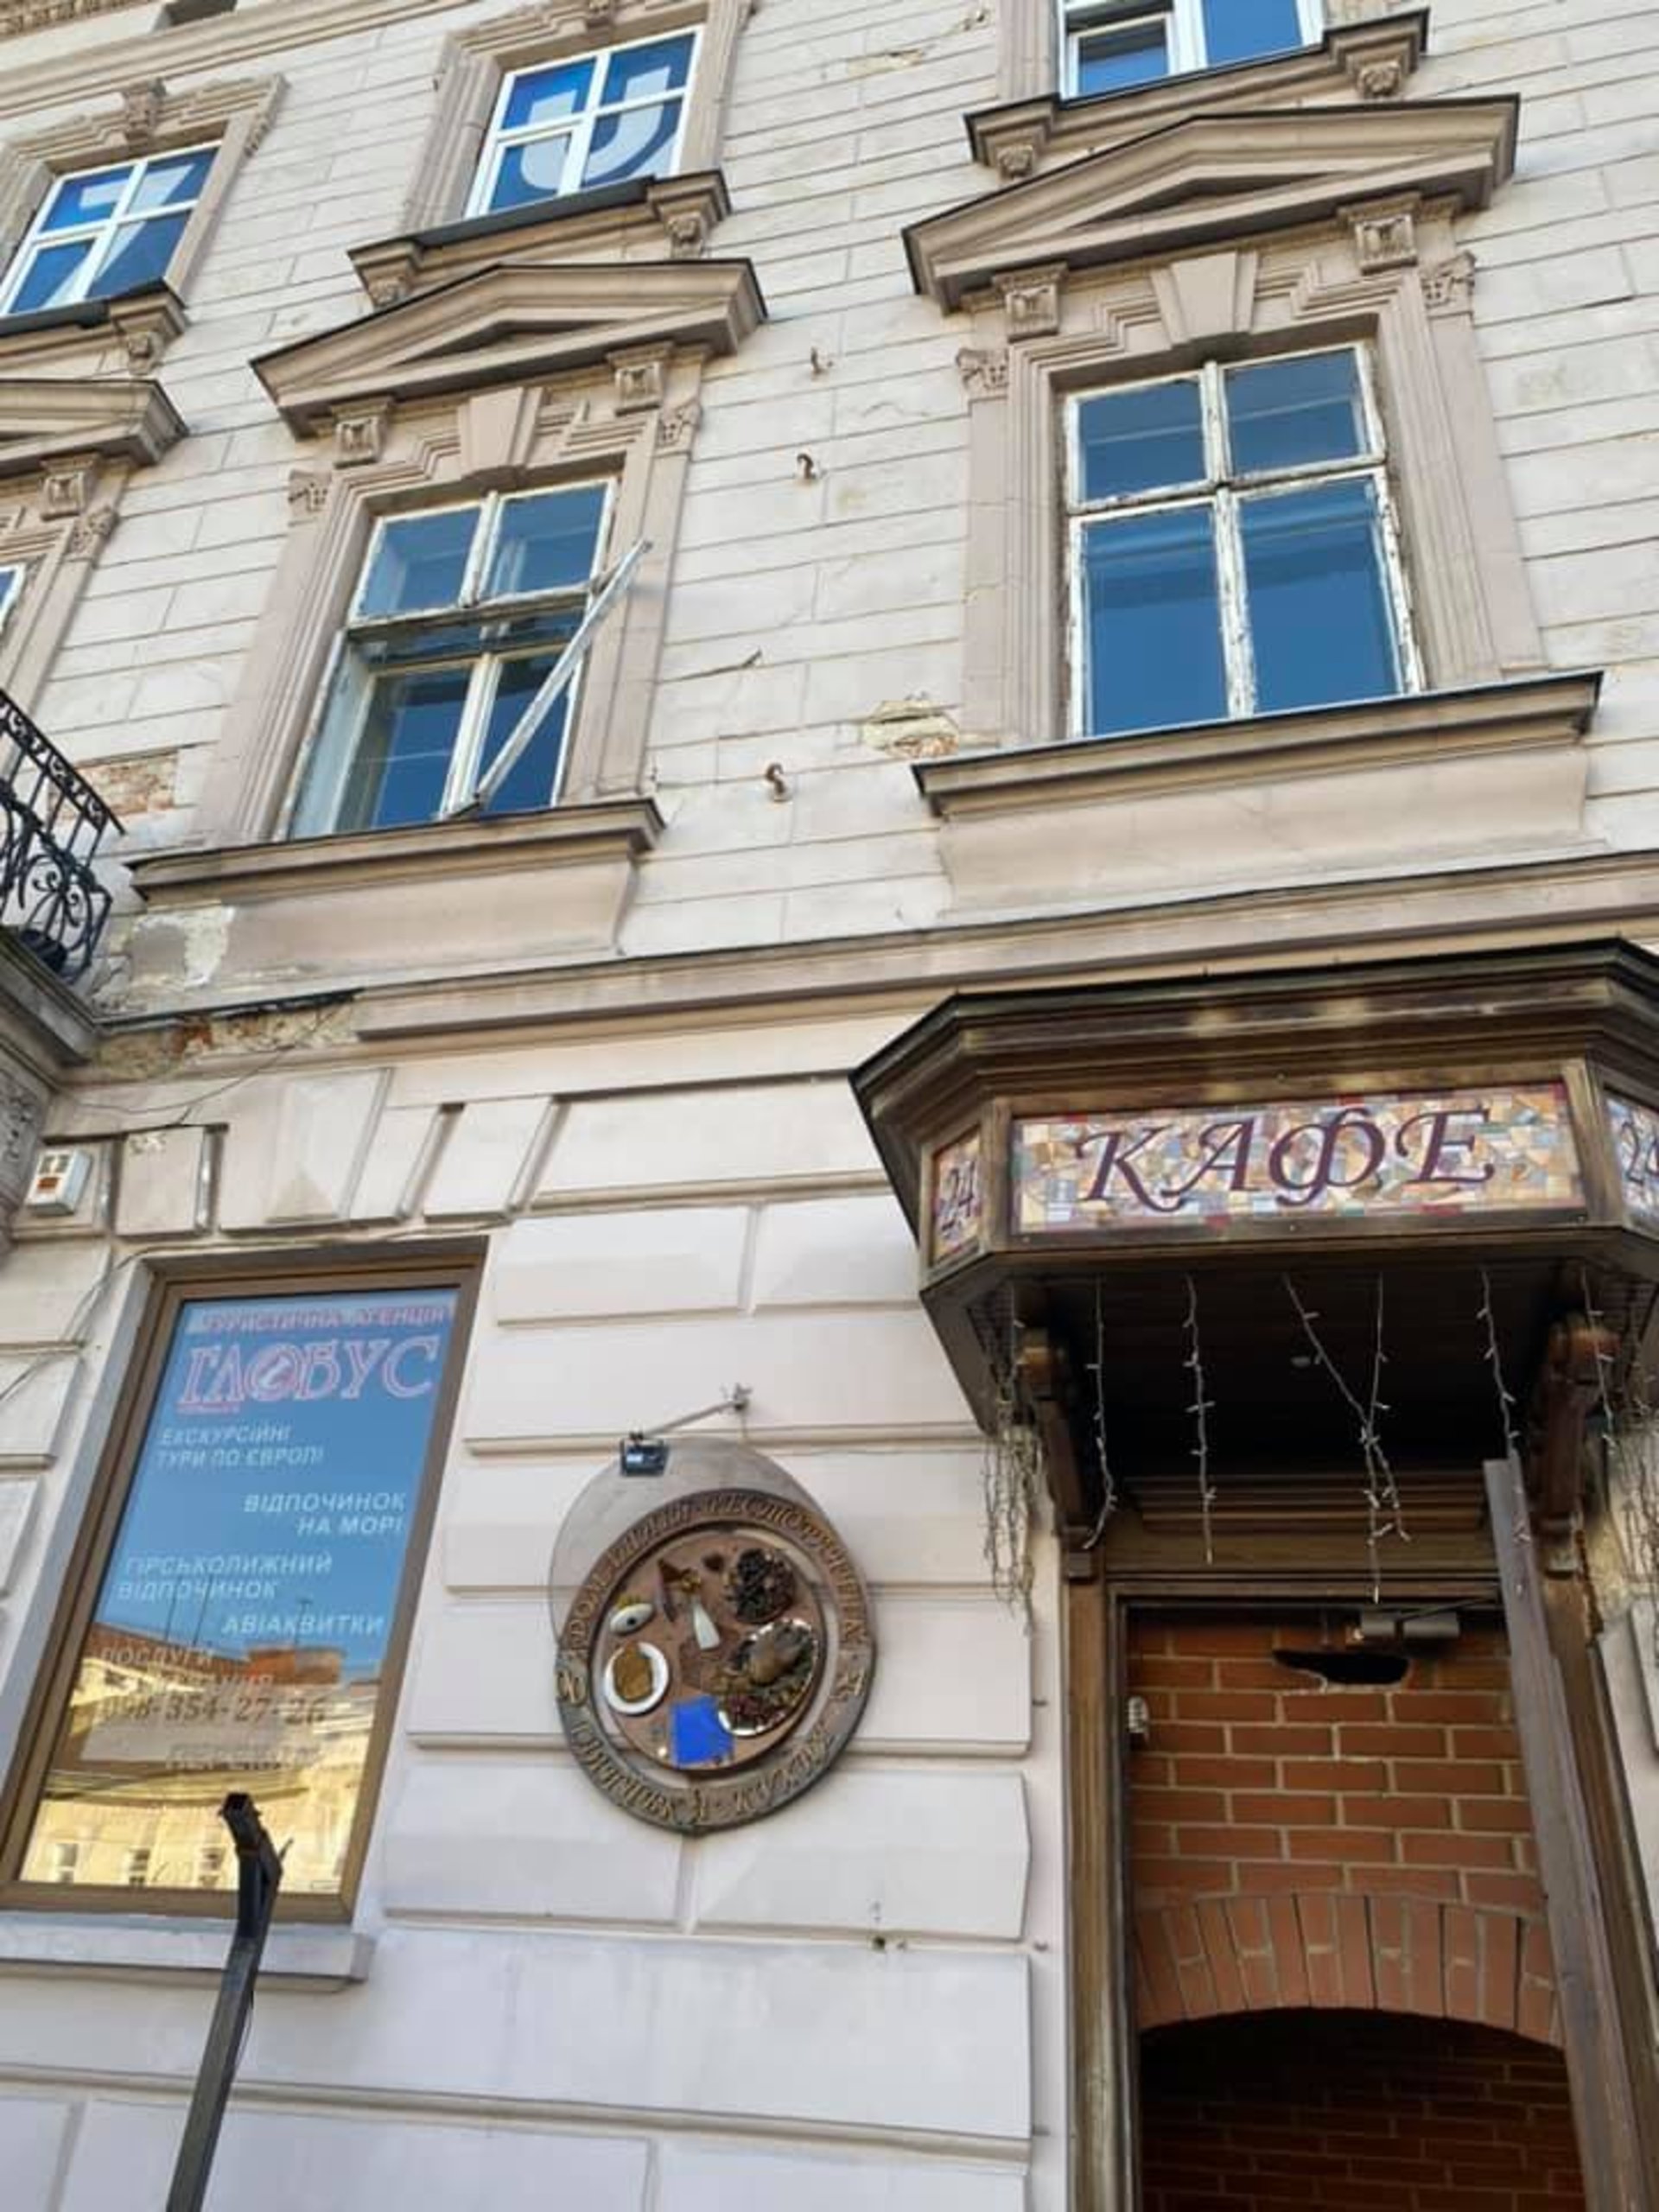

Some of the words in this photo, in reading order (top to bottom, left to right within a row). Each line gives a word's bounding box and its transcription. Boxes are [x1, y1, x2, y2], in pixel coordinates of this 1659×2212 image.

[1075, 1105, 1497, 1212] КАФЕ
[178, 1335, 440, 1404] ГЛОБУС
[156, 1449, 207, 1468] ТУРИ
[210, 1448, 241, 1467] ПО
[243, 1492, 407, 1513] ВІДПОЧИНОК
[296, 1516, 332, 1535] НА
[339, 1515, 404, 1535] МОРІ
[125, 1551, 333, 1577] ГІРСЬКОЛИЖНИЙ
[118, 1580, 278, 1601] ВІДПОЧИНОК
[220, 1613, 385, 1637] АВІАКВИТКИ
